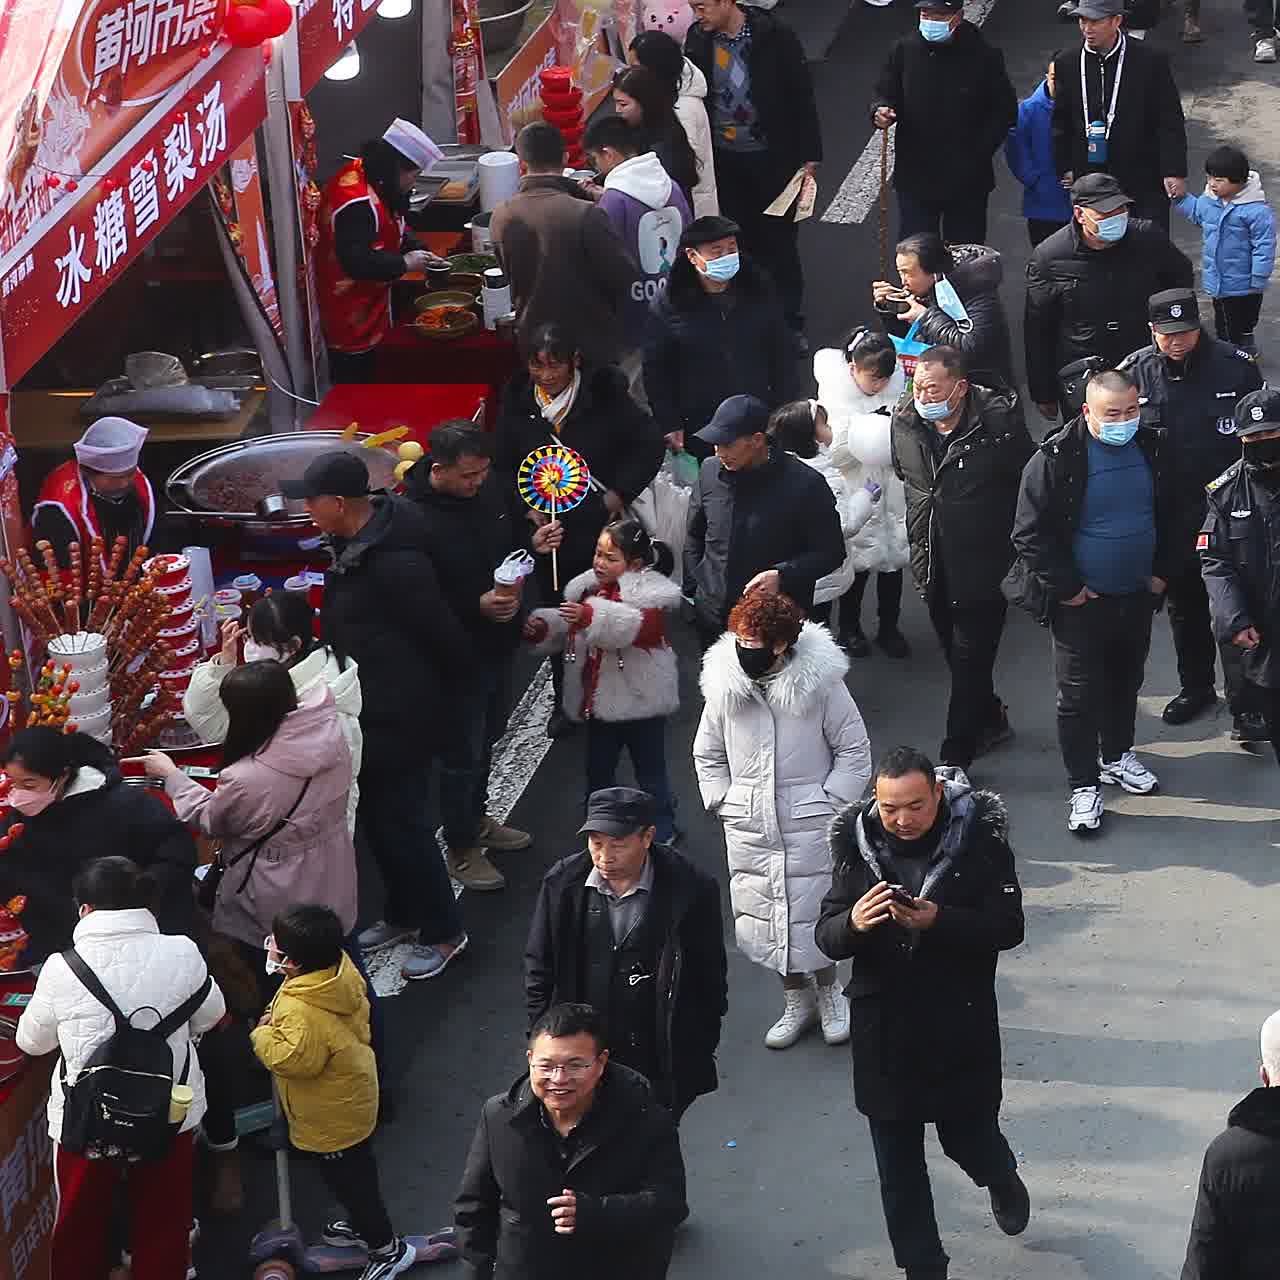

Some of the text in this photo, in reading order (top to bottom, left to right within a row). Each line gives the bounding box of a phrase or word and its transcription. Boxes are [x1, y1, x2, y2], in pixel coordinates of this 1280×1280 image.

[54, 80, 227, 308] 冰糖雪梨汤
